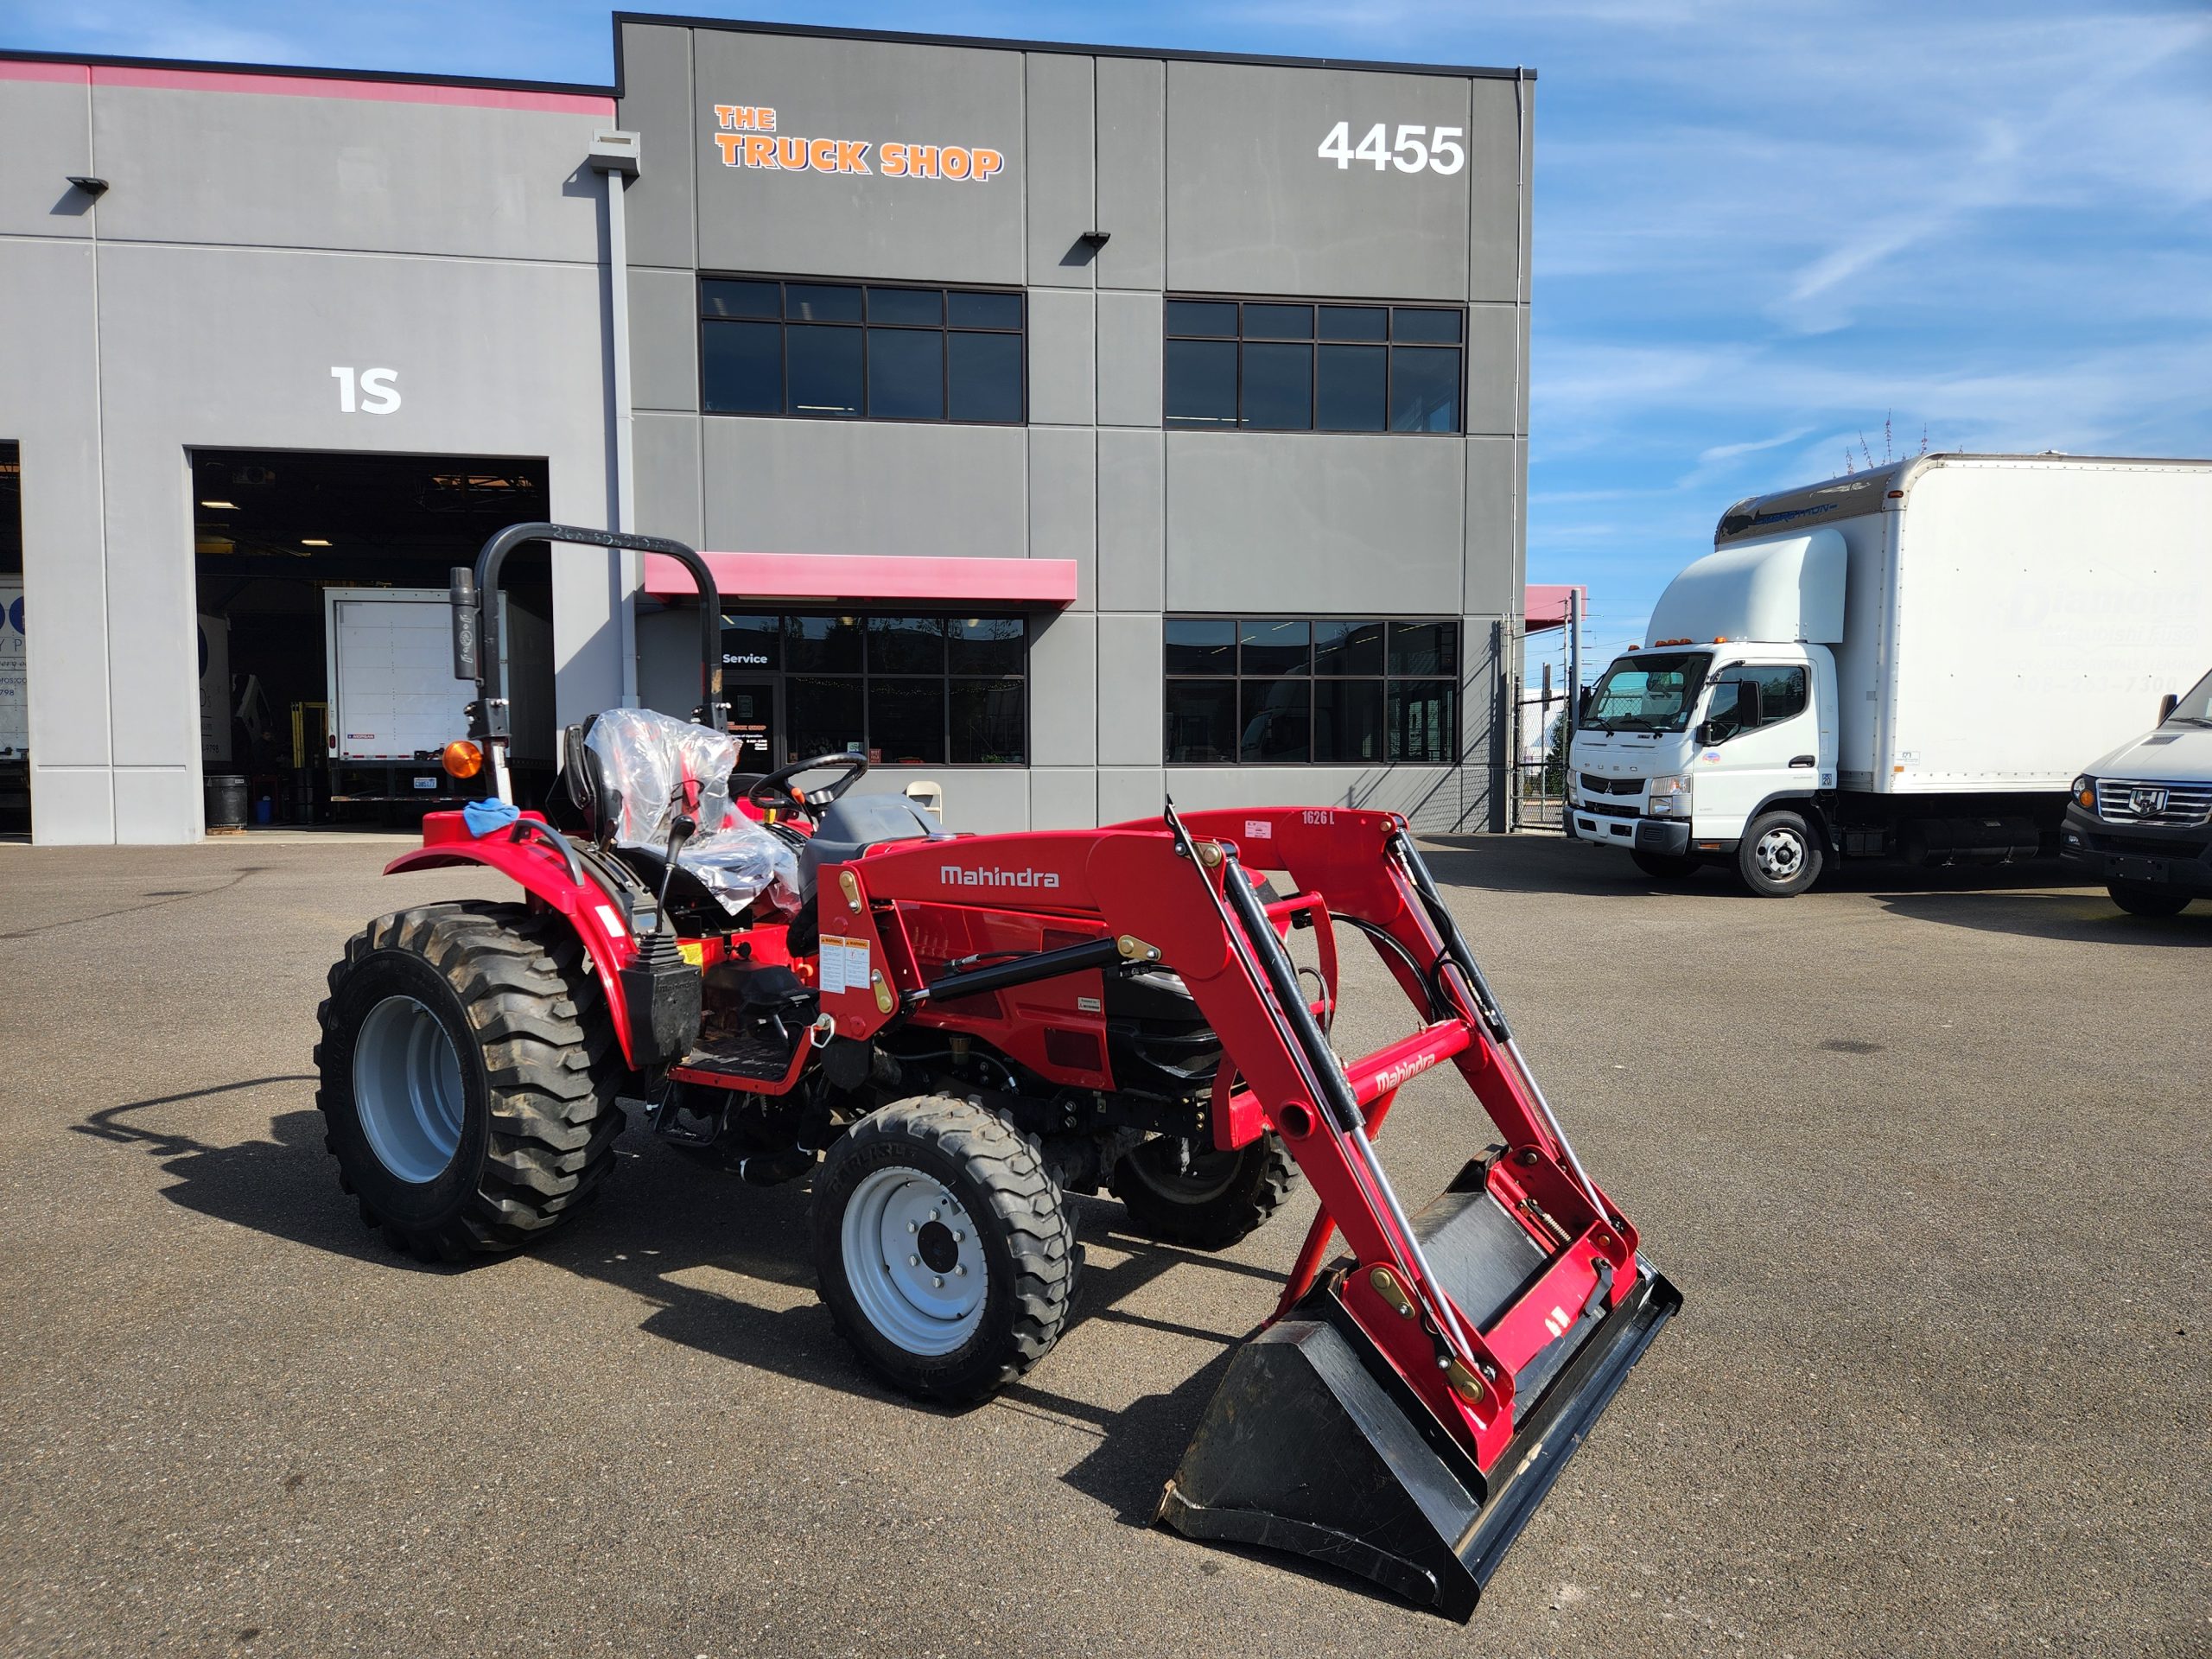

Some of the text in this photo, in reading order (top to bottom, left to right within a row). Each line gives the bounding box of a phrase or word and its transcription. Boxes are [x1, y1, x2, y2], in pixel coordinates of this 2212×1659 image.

[715, 105, 776, 131] THE
[715, 132, 1004, 181] TRUCK SHOP
[1318, 121, 1465, 175] 4455
[331, 366, 402, 415] 1S
[722, 653, 768, 664] Service
[1302, 810, 1327, 824] 1626
[941, 866, 1059, 887] Mahindra
[1376, 1053, 1435, 1093] Mahindra
